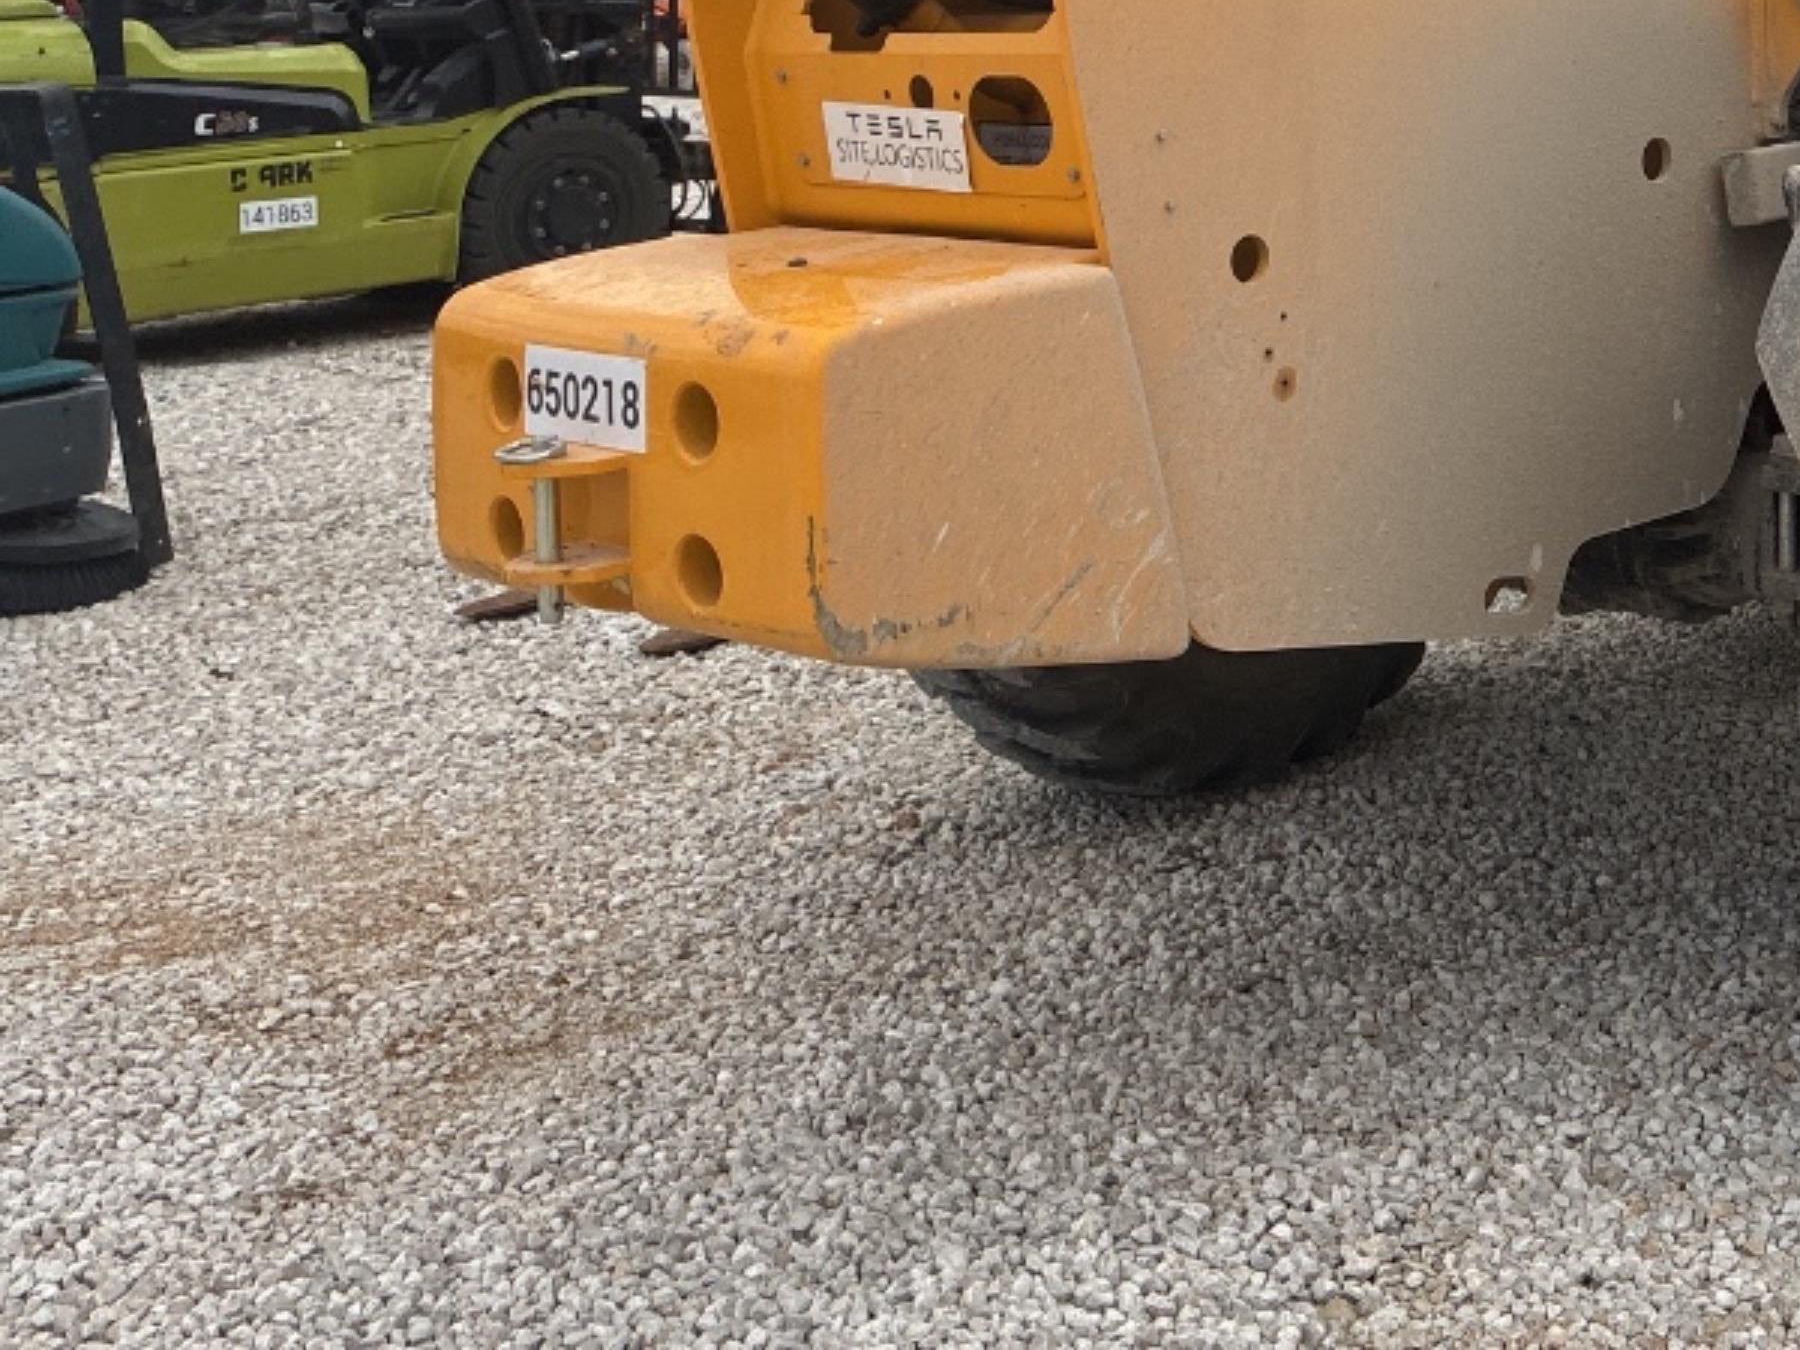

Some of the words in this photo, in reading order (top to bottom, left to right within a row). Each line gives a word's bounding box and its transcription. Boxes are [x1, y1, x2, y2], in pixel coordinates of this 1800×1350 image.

[845, 111, 943, 142] TESLA
[230, 160, 313, 193] CARK
[528, 368, 640, 430] 650218
